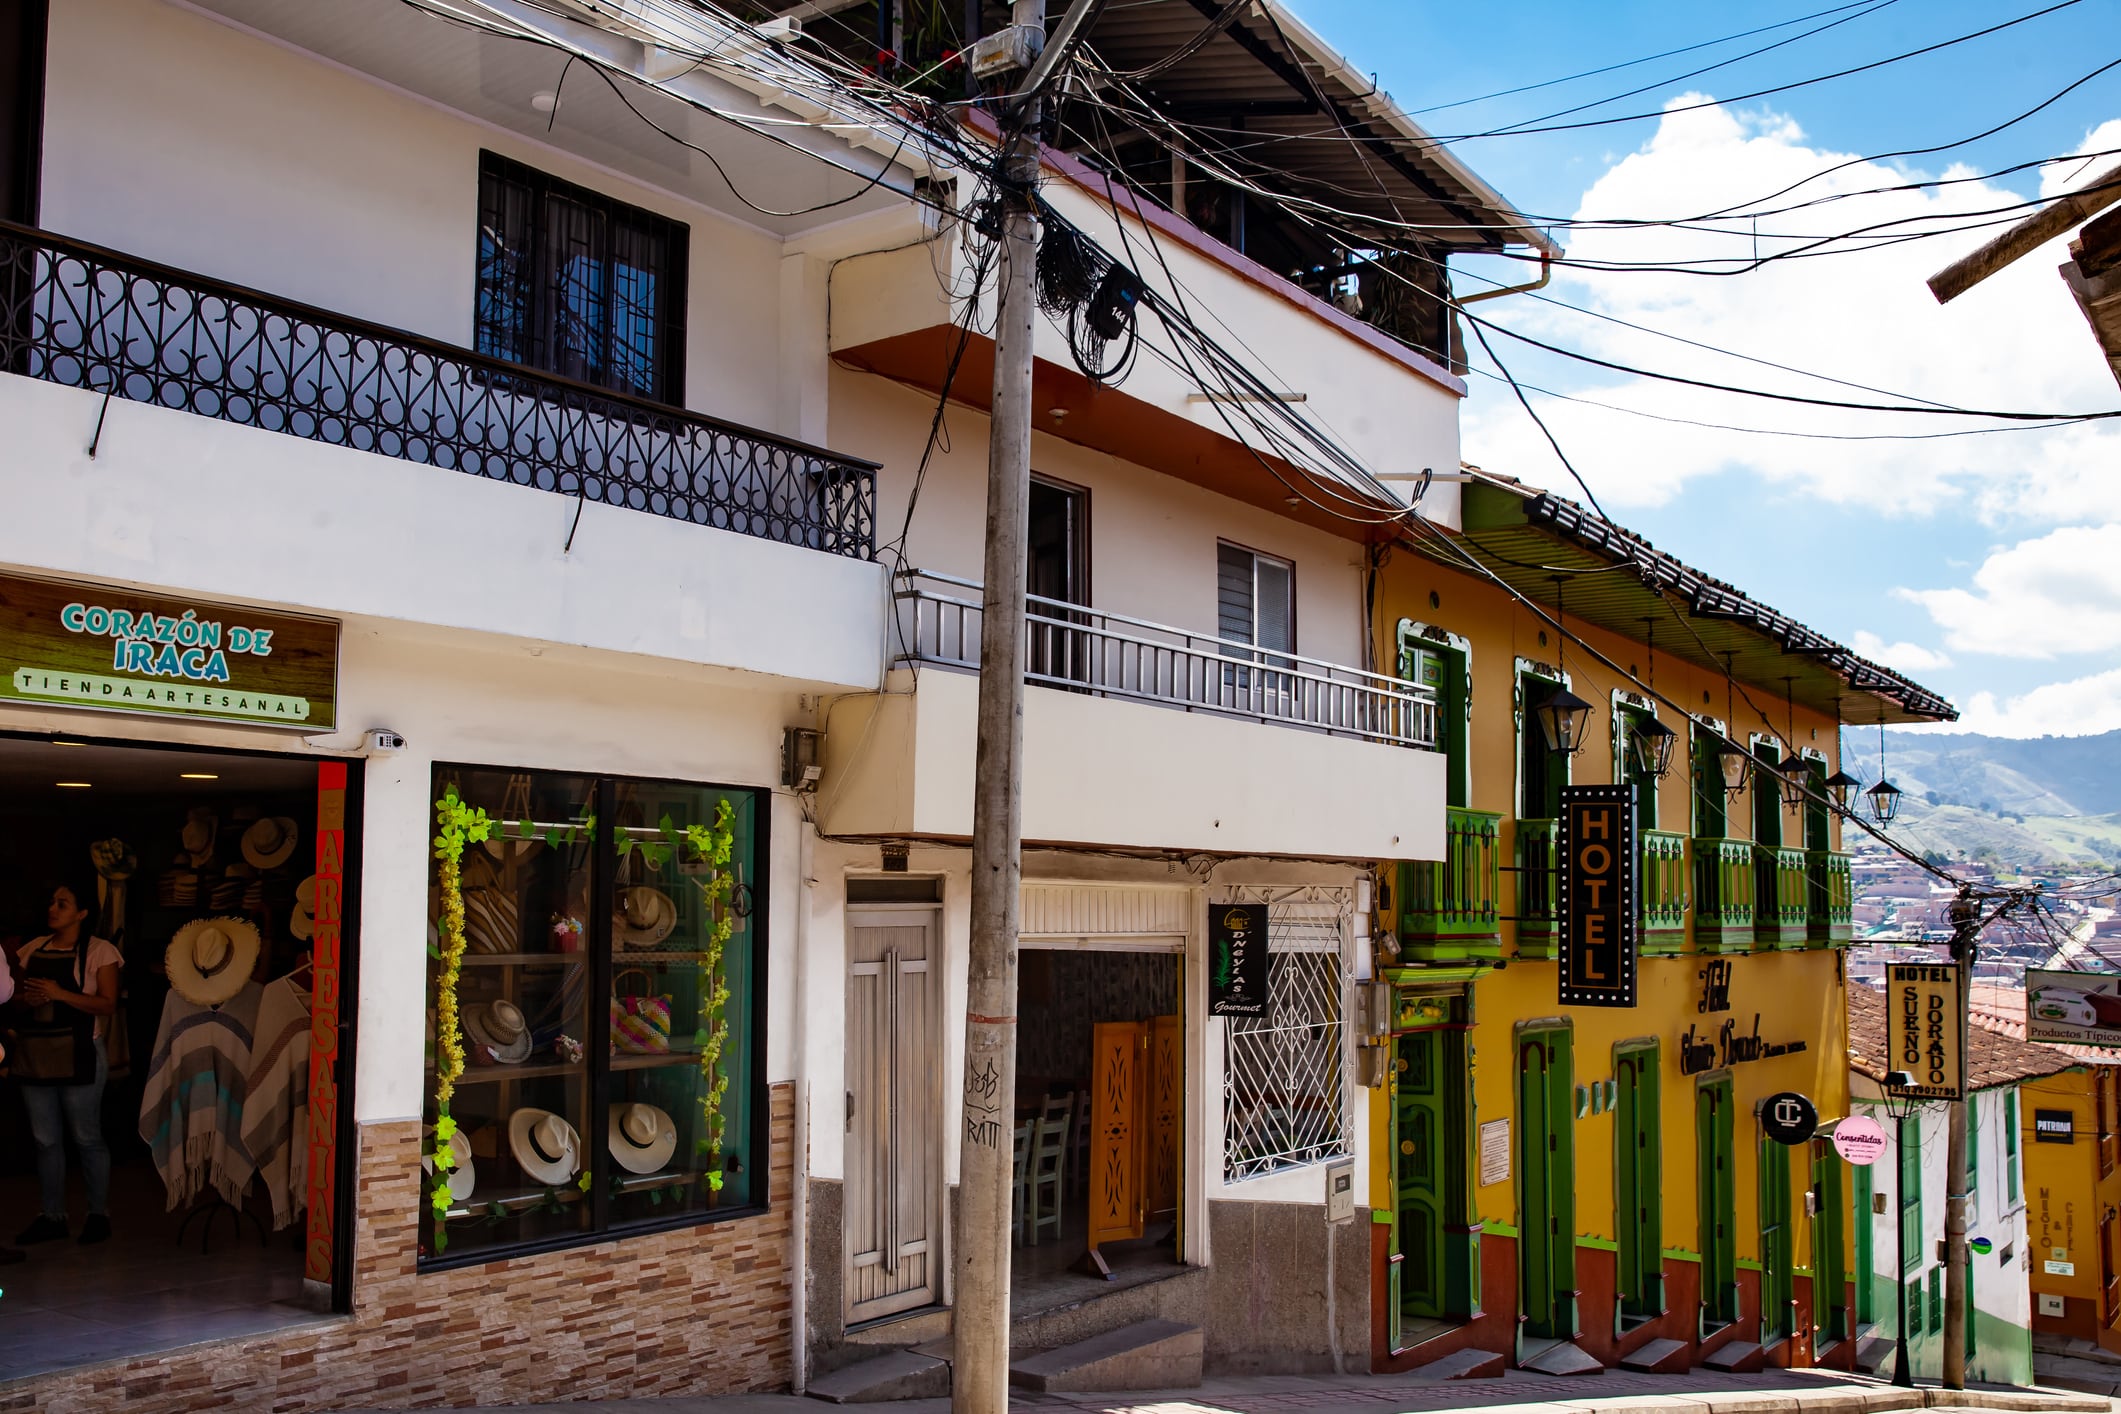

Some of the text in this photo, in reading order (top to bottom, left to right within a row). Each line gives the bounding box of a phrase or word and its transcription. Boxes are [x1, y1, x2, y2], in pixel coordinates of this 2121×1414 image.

[1112, 306, 1126, 323] 144
[61, 603, 273, 656] CORAZÓN DE
[114, 638, 230, 682] IRACA
[22, 674, 301, 714] TIENDA ARTESANAL
[1580, 810, 1611, 979] HOTEL
[1894, 967, 1951, 982] HOTEL
[1214, 1001, 1262, 1013] Gourmet
[1904, 986, 1920, 1064] SUEÑO
[1926, 995, 1946, 1084] DORADO
[2031, 1027, 2121, 1042] Productos Típico
[308, 831, 341, 1282] ARTESANIAS
[1836, 1132, 1882, 1145] Consentidas
